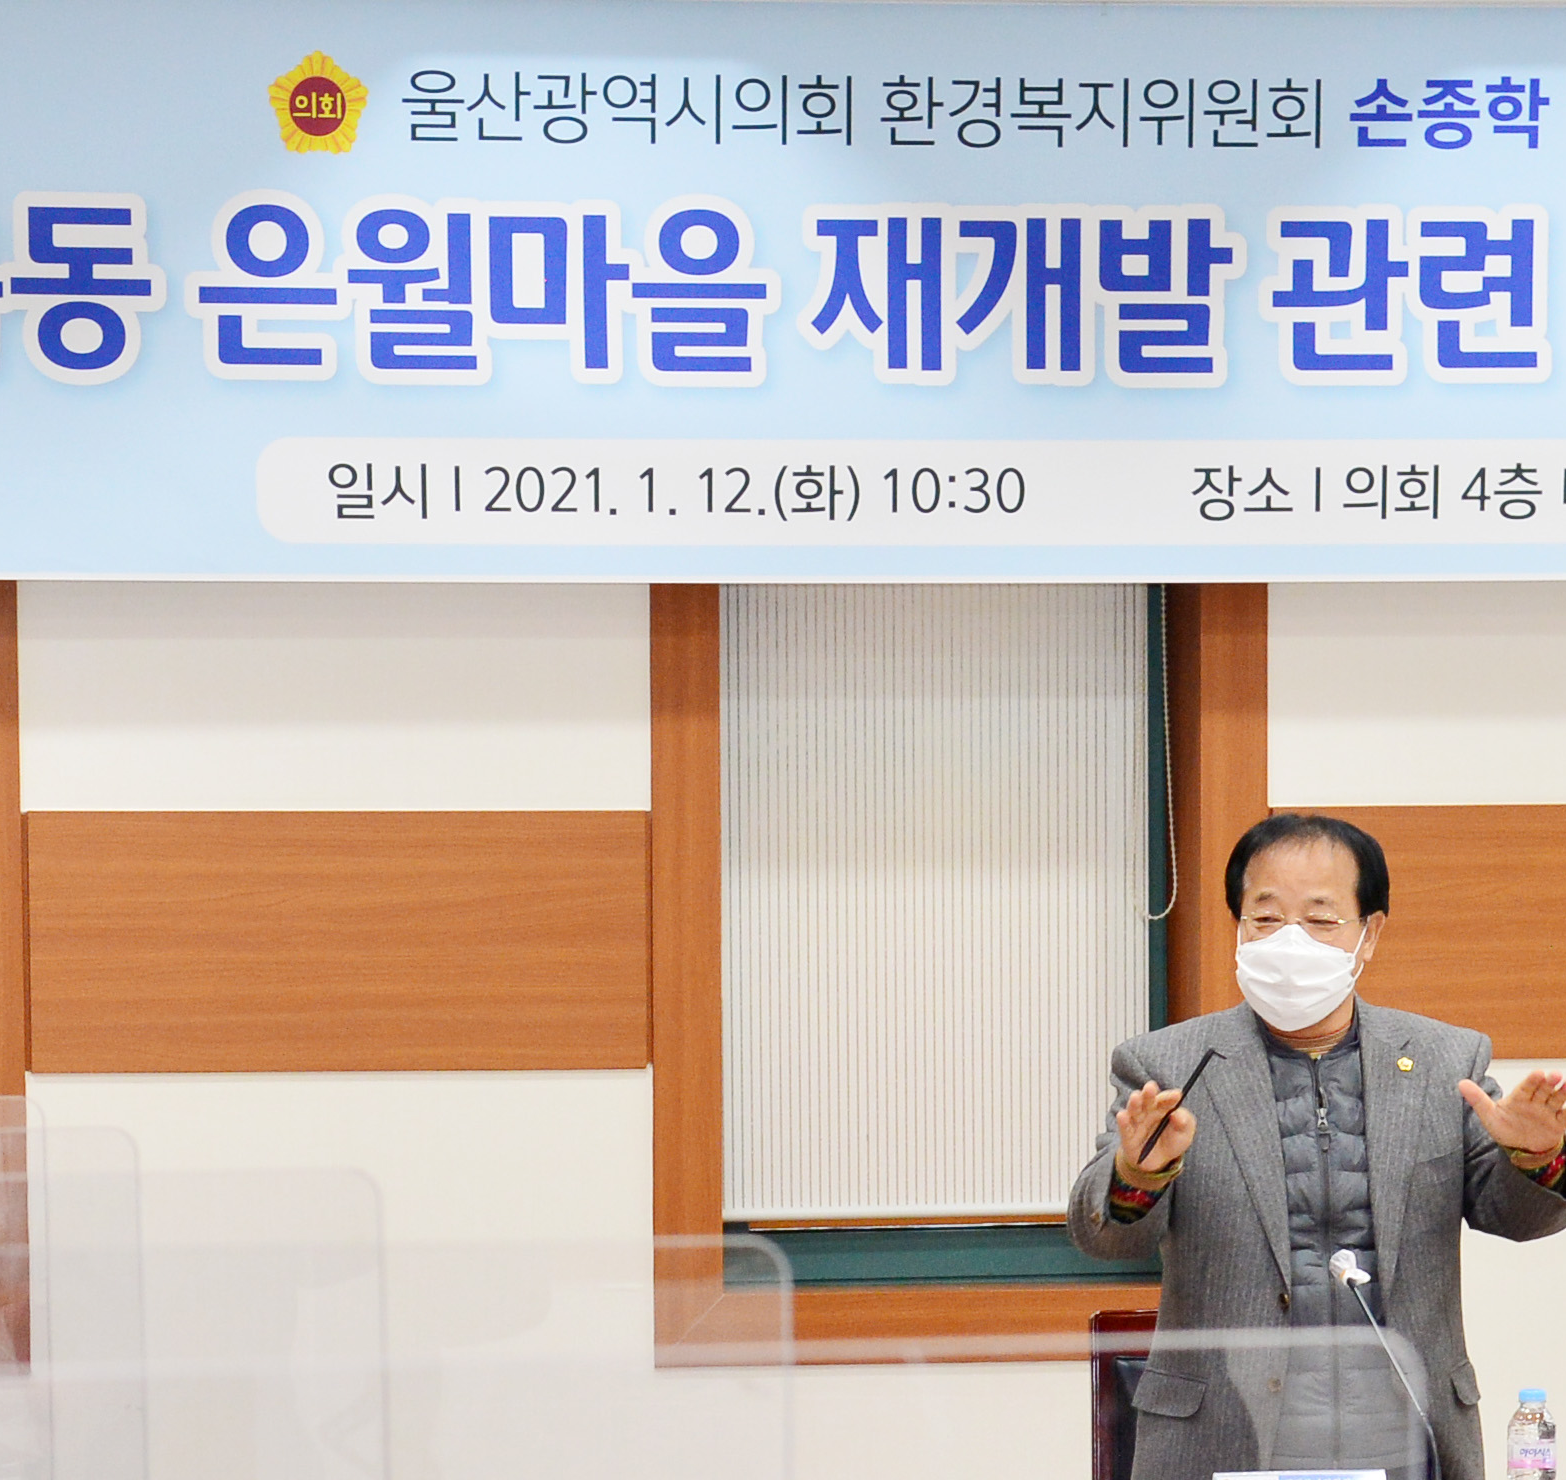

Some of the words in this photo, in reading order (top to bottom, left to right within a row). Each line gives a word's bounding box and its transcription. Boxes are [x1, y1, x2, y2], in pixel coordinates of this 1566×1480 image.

[292, 91, 342, 119] 의회
[402, 70, 852, 146] 울산광역시의회
[880, 75, 1321, 148] 환경복지위원회
[1350, 77, 1549, 149] 손종학
[197, 204, 768, 373] 은월마을
[810, 217, 1234, 375] 재개발
[1271, 219, 1539, 372] 관련
[328, 463, 428, 519] 일시
[485, 466, 617, 516] 2021.
[639, 467, 677, 516] 1.
[699, 464, 860, 522] 12.(화)
[883, 467, 1025, 514] 10:30
[1192, 464, 1293, 521] 장소
[1342, 464, 1440, 519] 의회
[1462, 462, 1543, 519] 4층
